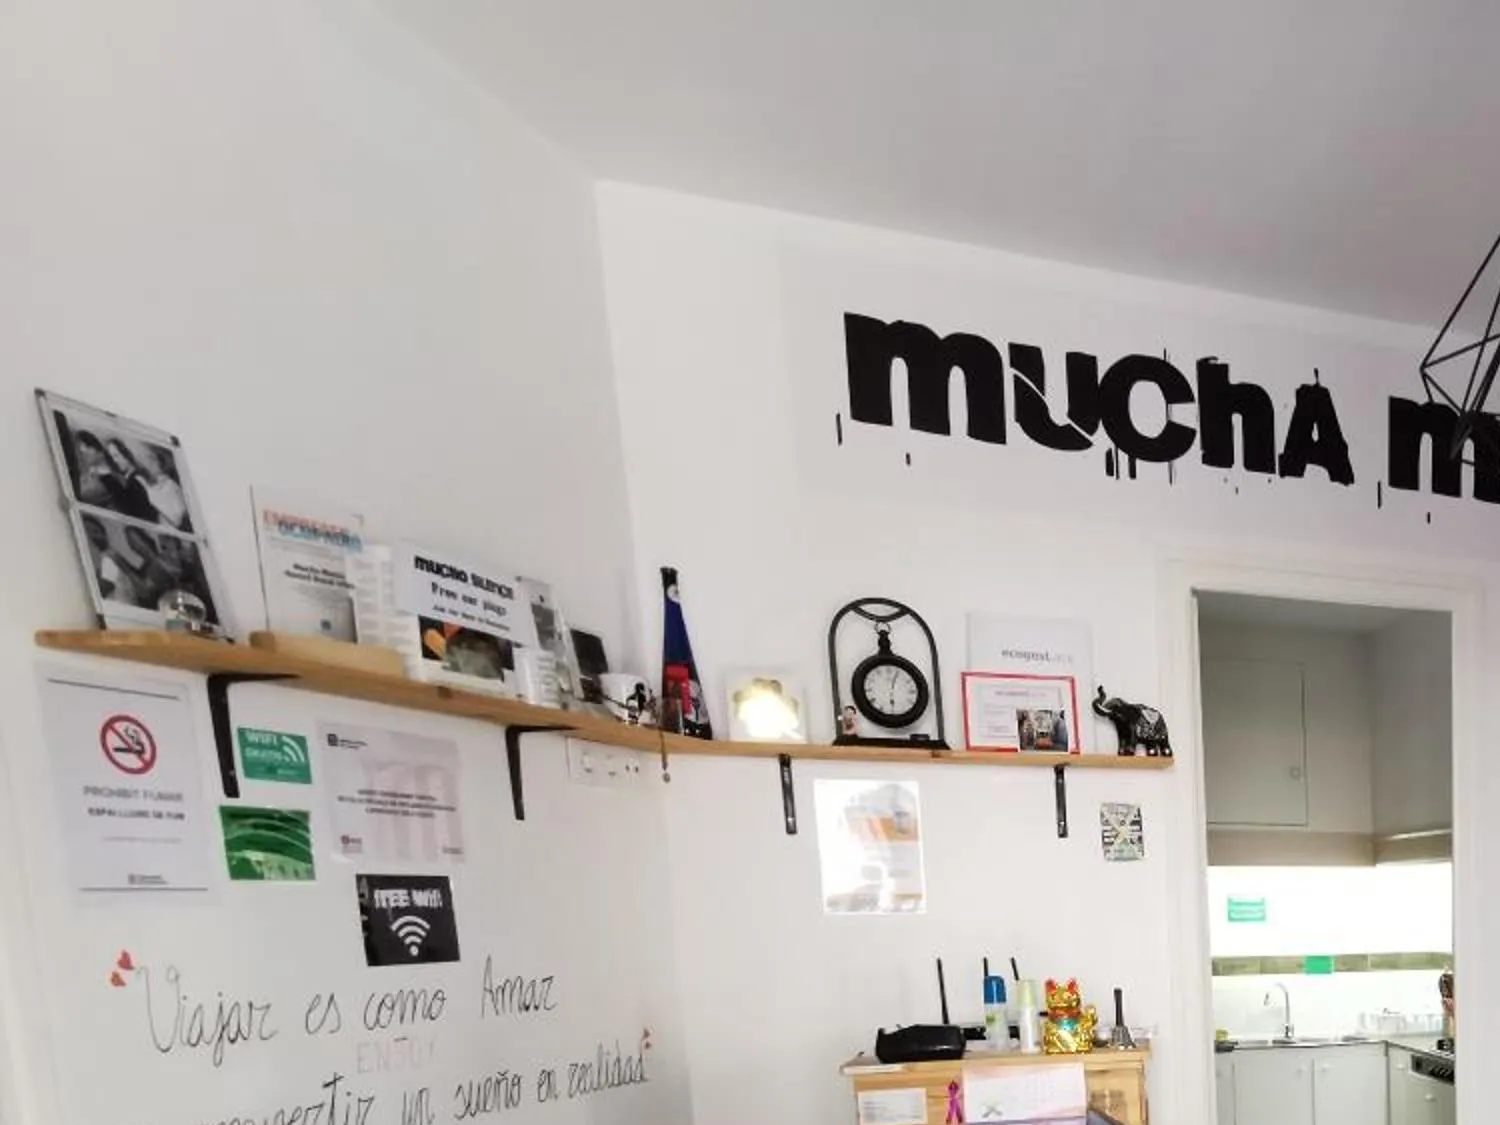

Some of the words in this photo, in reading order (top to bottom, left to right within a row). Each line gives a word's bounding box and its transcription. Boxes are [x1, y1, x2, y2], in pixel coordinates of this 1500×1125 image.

[135, 963, 278, 1067] Viajar
[304, 991, 341, 1035] es
[362, 986, 447, 1031] como
[480, 954, 558, 1020] Amar
